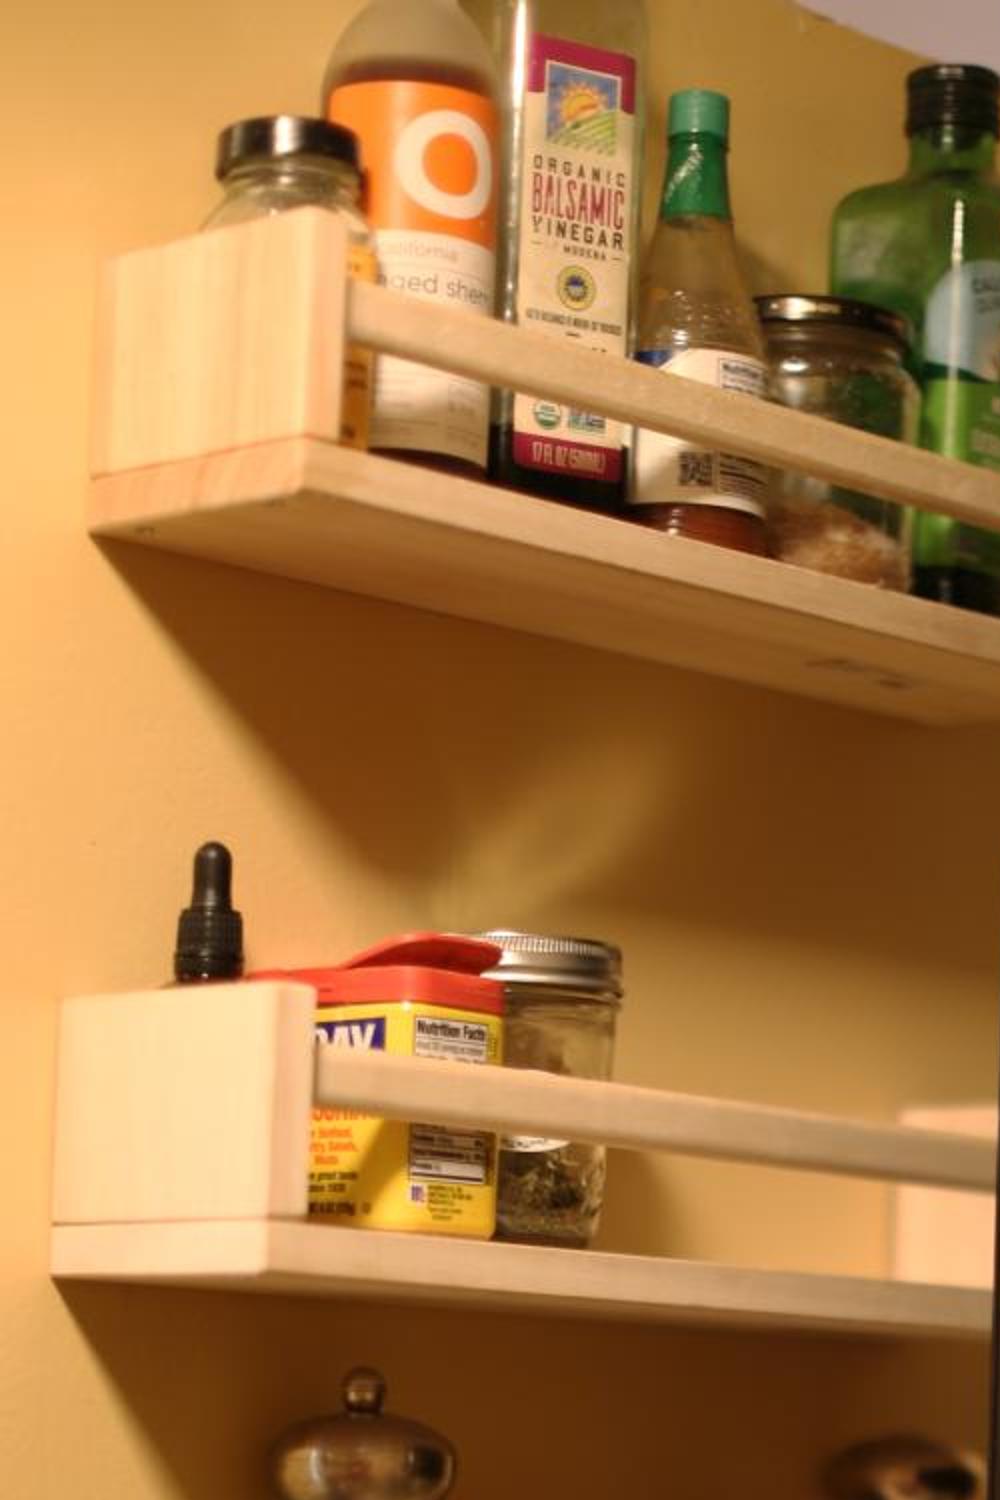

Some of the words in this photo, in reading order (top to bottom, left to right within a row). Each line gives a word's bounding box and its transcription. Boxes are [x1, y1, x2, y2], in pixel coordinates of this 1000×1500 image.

[533, 154, 625, 188] ORGANIC
[531, 171, 626, 231] BALSAMIC
[531, 214, 624, 251] VINEGAR
[417, 1019, 462, 1037] Nutrition
